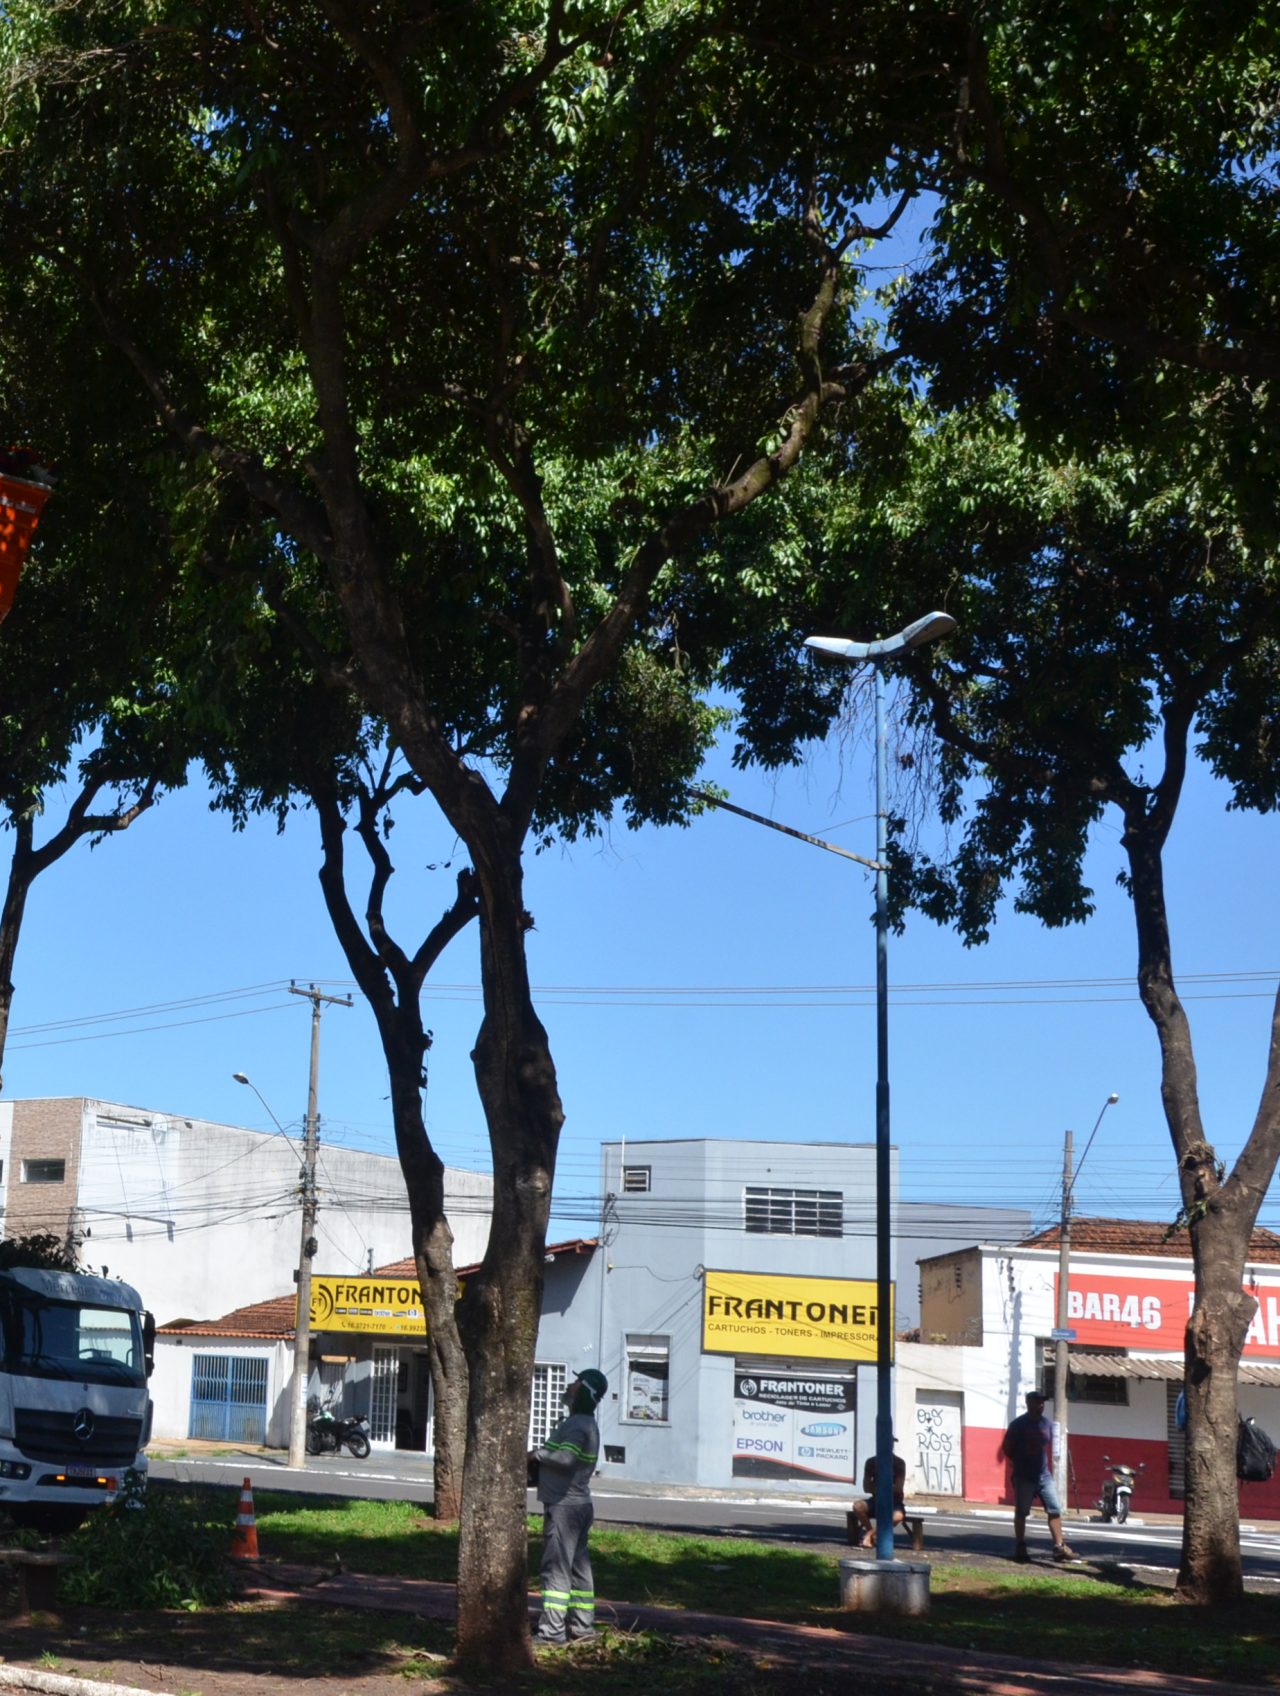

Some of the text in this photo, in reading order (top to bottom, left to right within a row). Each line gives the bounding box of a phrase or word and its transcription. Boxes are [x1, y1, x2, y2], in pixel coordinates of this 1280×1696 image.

[335, 1284, 423, 1305] FRANTON
[1068, 1290, 1162, 1330] BAR46
[708, 1322, 878, 1342] CARTUCHOS TONERS IMPRESSOR
[760, 1379, 844, 1397] FRANTONER
[742, 1409, 786, 1423] brother
[736, 1437, 783, 1452] EPSON
[816, 1453, 849, 1461] PACKARD
